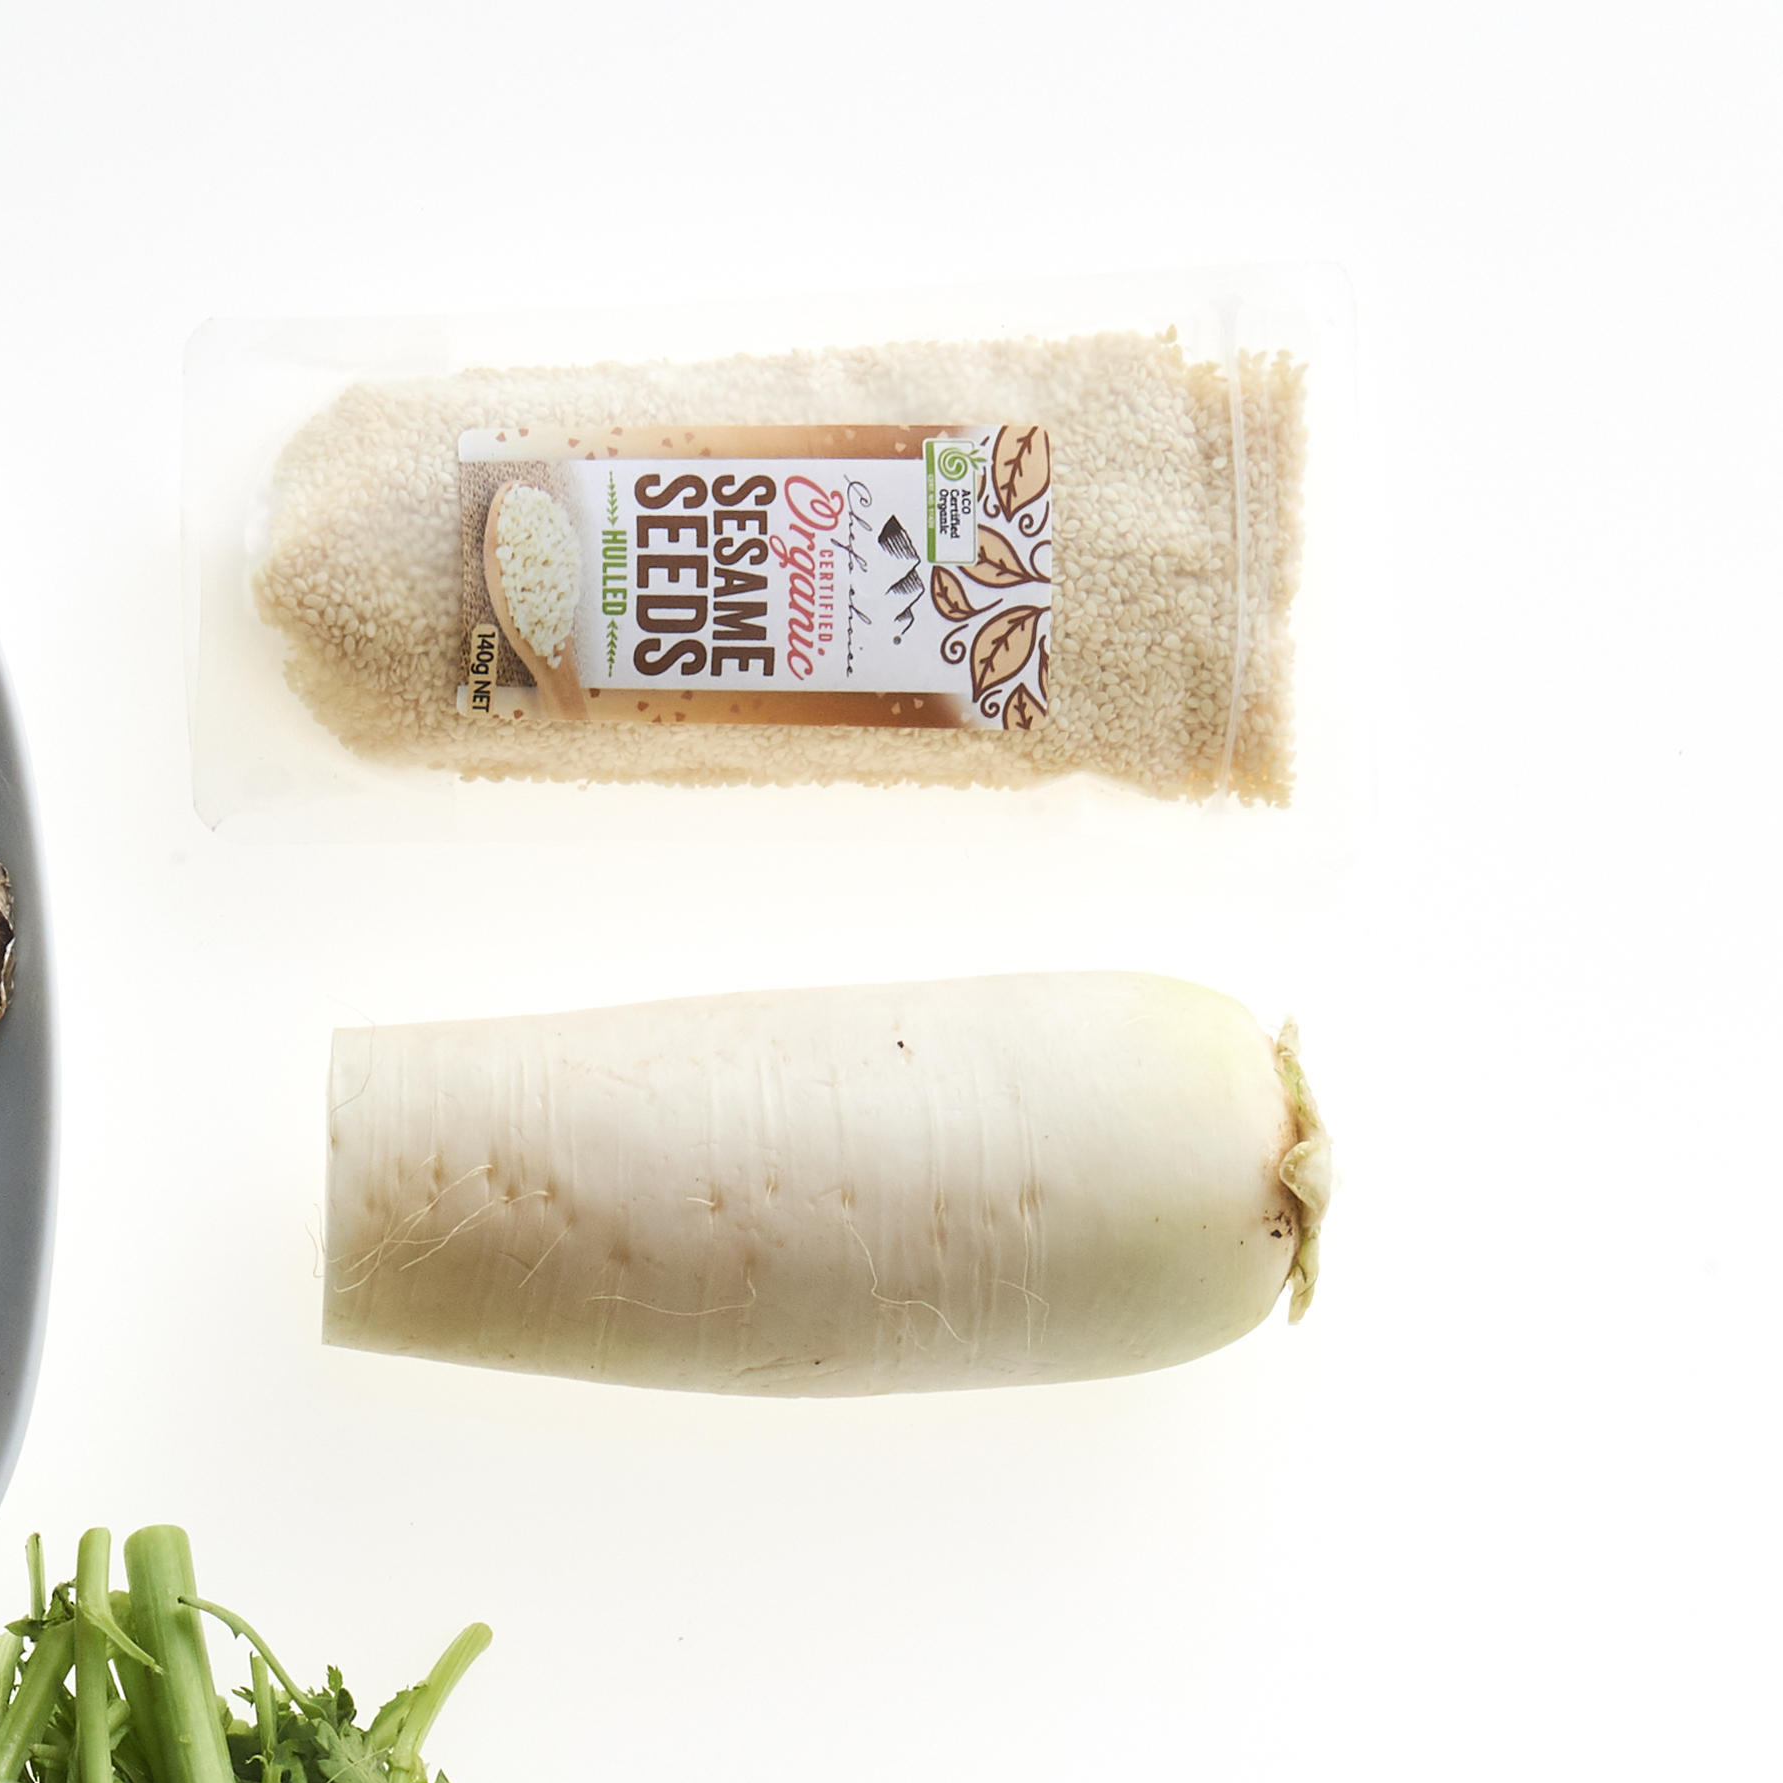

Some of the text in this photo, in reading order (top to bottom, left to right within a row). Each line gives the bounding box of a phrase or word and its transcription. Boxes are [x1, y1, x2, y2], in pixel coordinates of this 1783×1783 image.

[937, 488, 949, 535] Organic
[949, 488, 961, 539] Certified
[961, 488, 972, 515] ACO
[601, 529, 628, 617] HULLED
[633, 473, 709, 677] SEEDS
[710, 474, 777, 677] SESAME
[768, 475, 845, 682] Organic
[818, 548, 835, 643] CERTIFIED
[470, 631, 497, 714] 140g NET
[845, 583, 873, 679] choice
